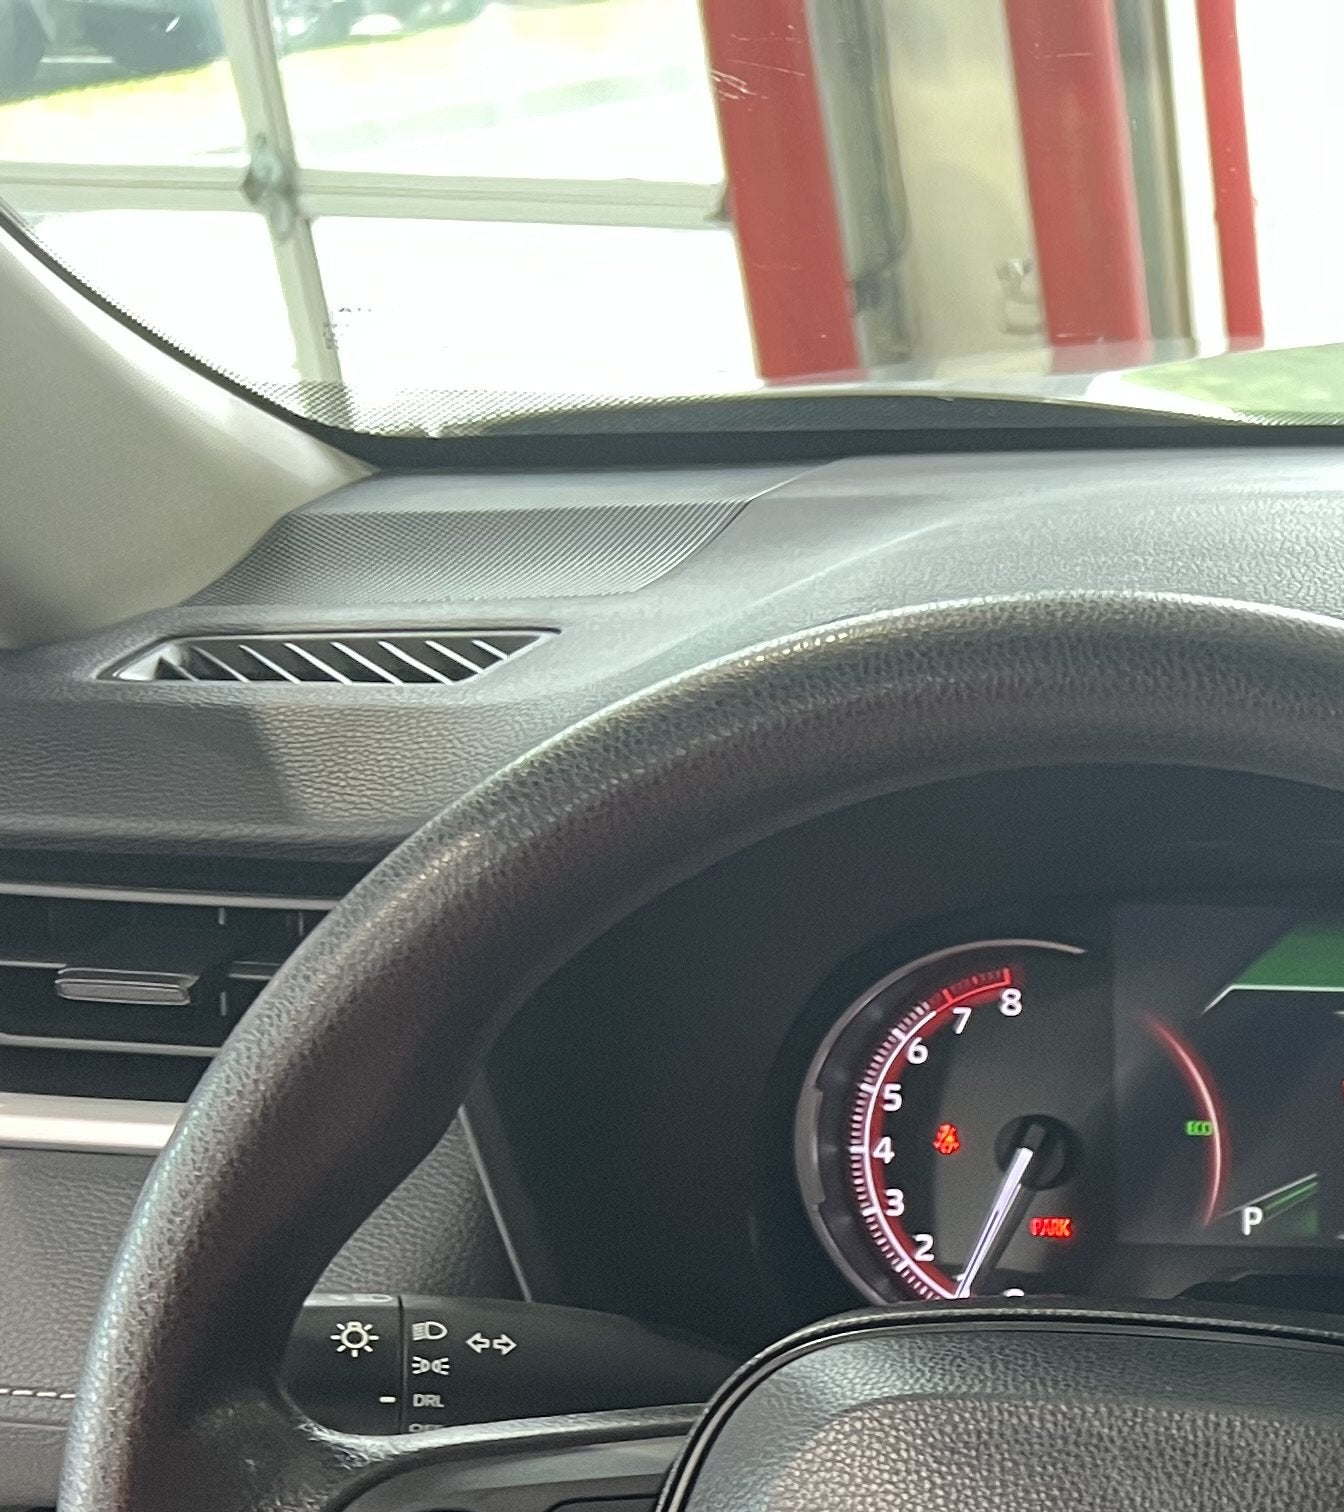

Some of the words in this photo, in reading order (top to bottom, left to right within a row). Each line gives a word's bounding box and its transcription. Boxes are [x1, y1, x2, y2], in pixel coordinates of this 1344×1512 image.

[1000, 988, 1022, 1016] 8
[953, 1007, 972, 1034] 7
[907, 1038, 928, 1064] 6
[883, 1084, 902, 1111] 5
[873, 1137, 894, 1164] 4
[885, 1189, 904, 1216] 3
[1031, 1217, 1072, 1237] PARK
[1243, 1206, 1263, 1236] P
[914, 1234, 934, 1261] 2
[413, 1394, 444, 1408] DRL
